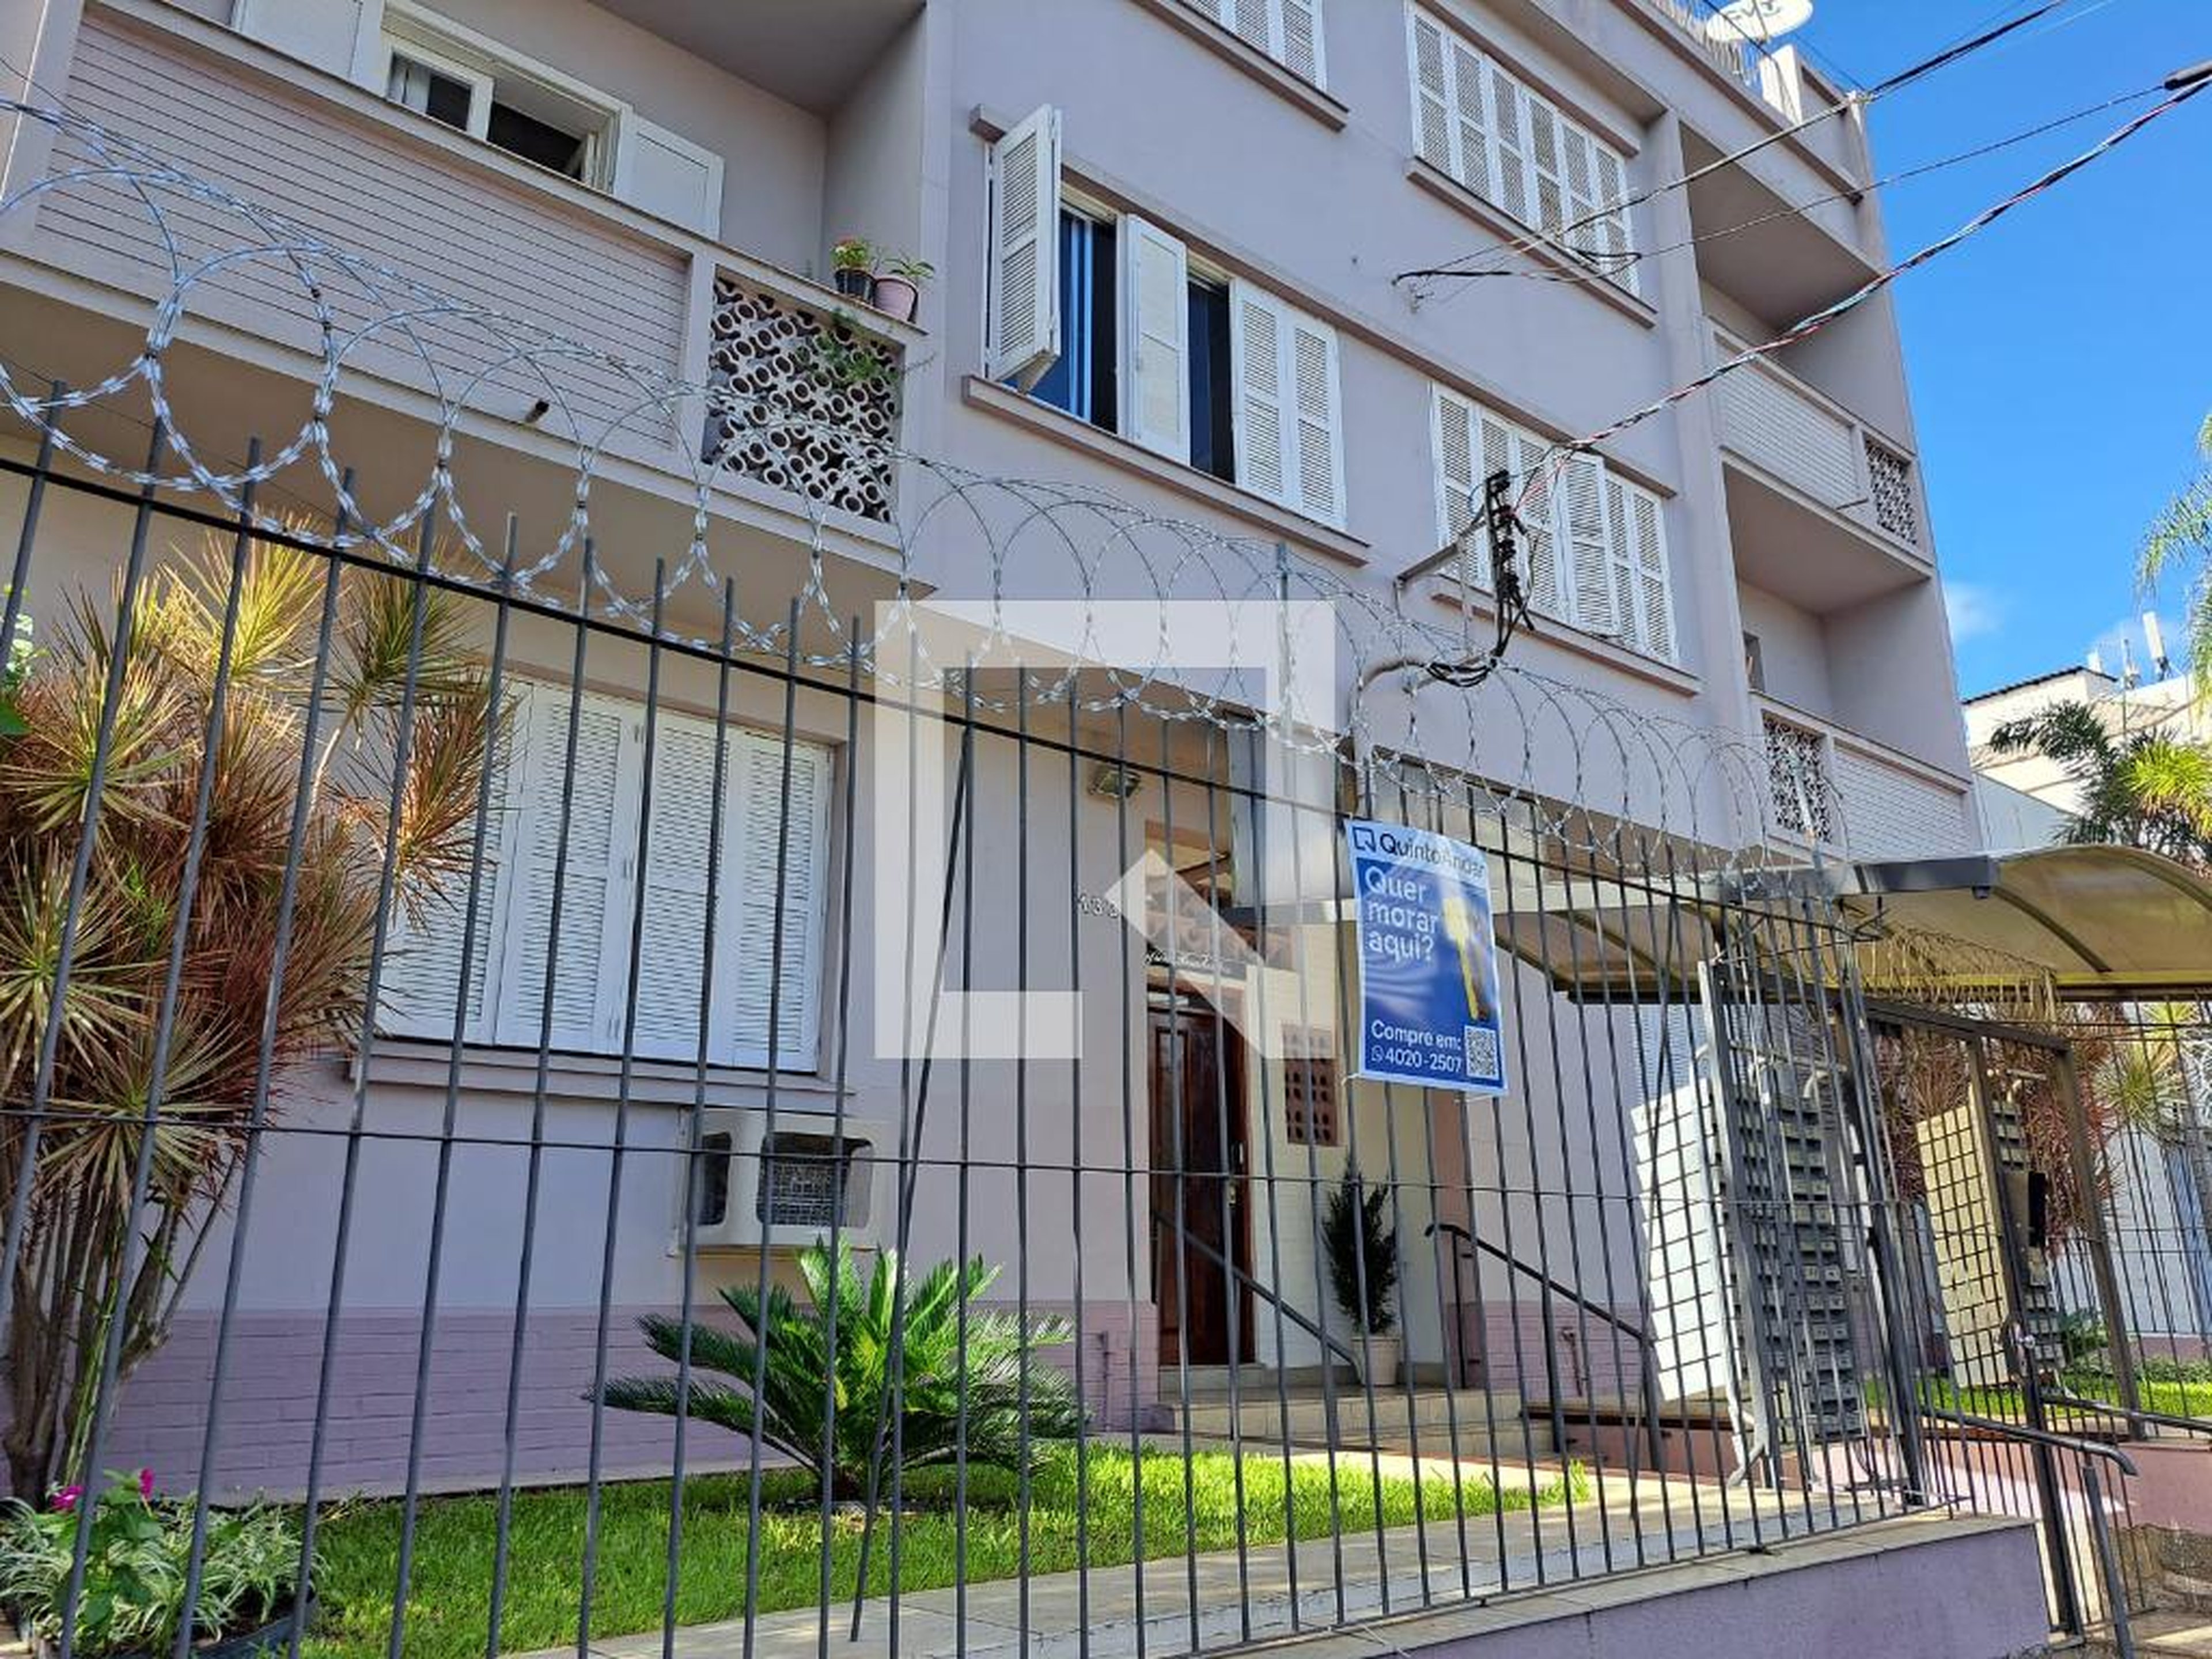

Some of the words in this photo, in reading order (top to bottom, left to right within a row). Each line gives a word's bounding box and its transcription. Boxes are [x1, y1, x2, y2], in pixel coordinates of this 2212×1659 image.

[1366, 866, 1426, 903] Quer
[1369, 901, 1438, 934] morar
[1369, 931, 1434, 962] aqui?
[1372, 1020, 1433, 1047] Compre
[1436, 1034, 1461, 1051] em:
